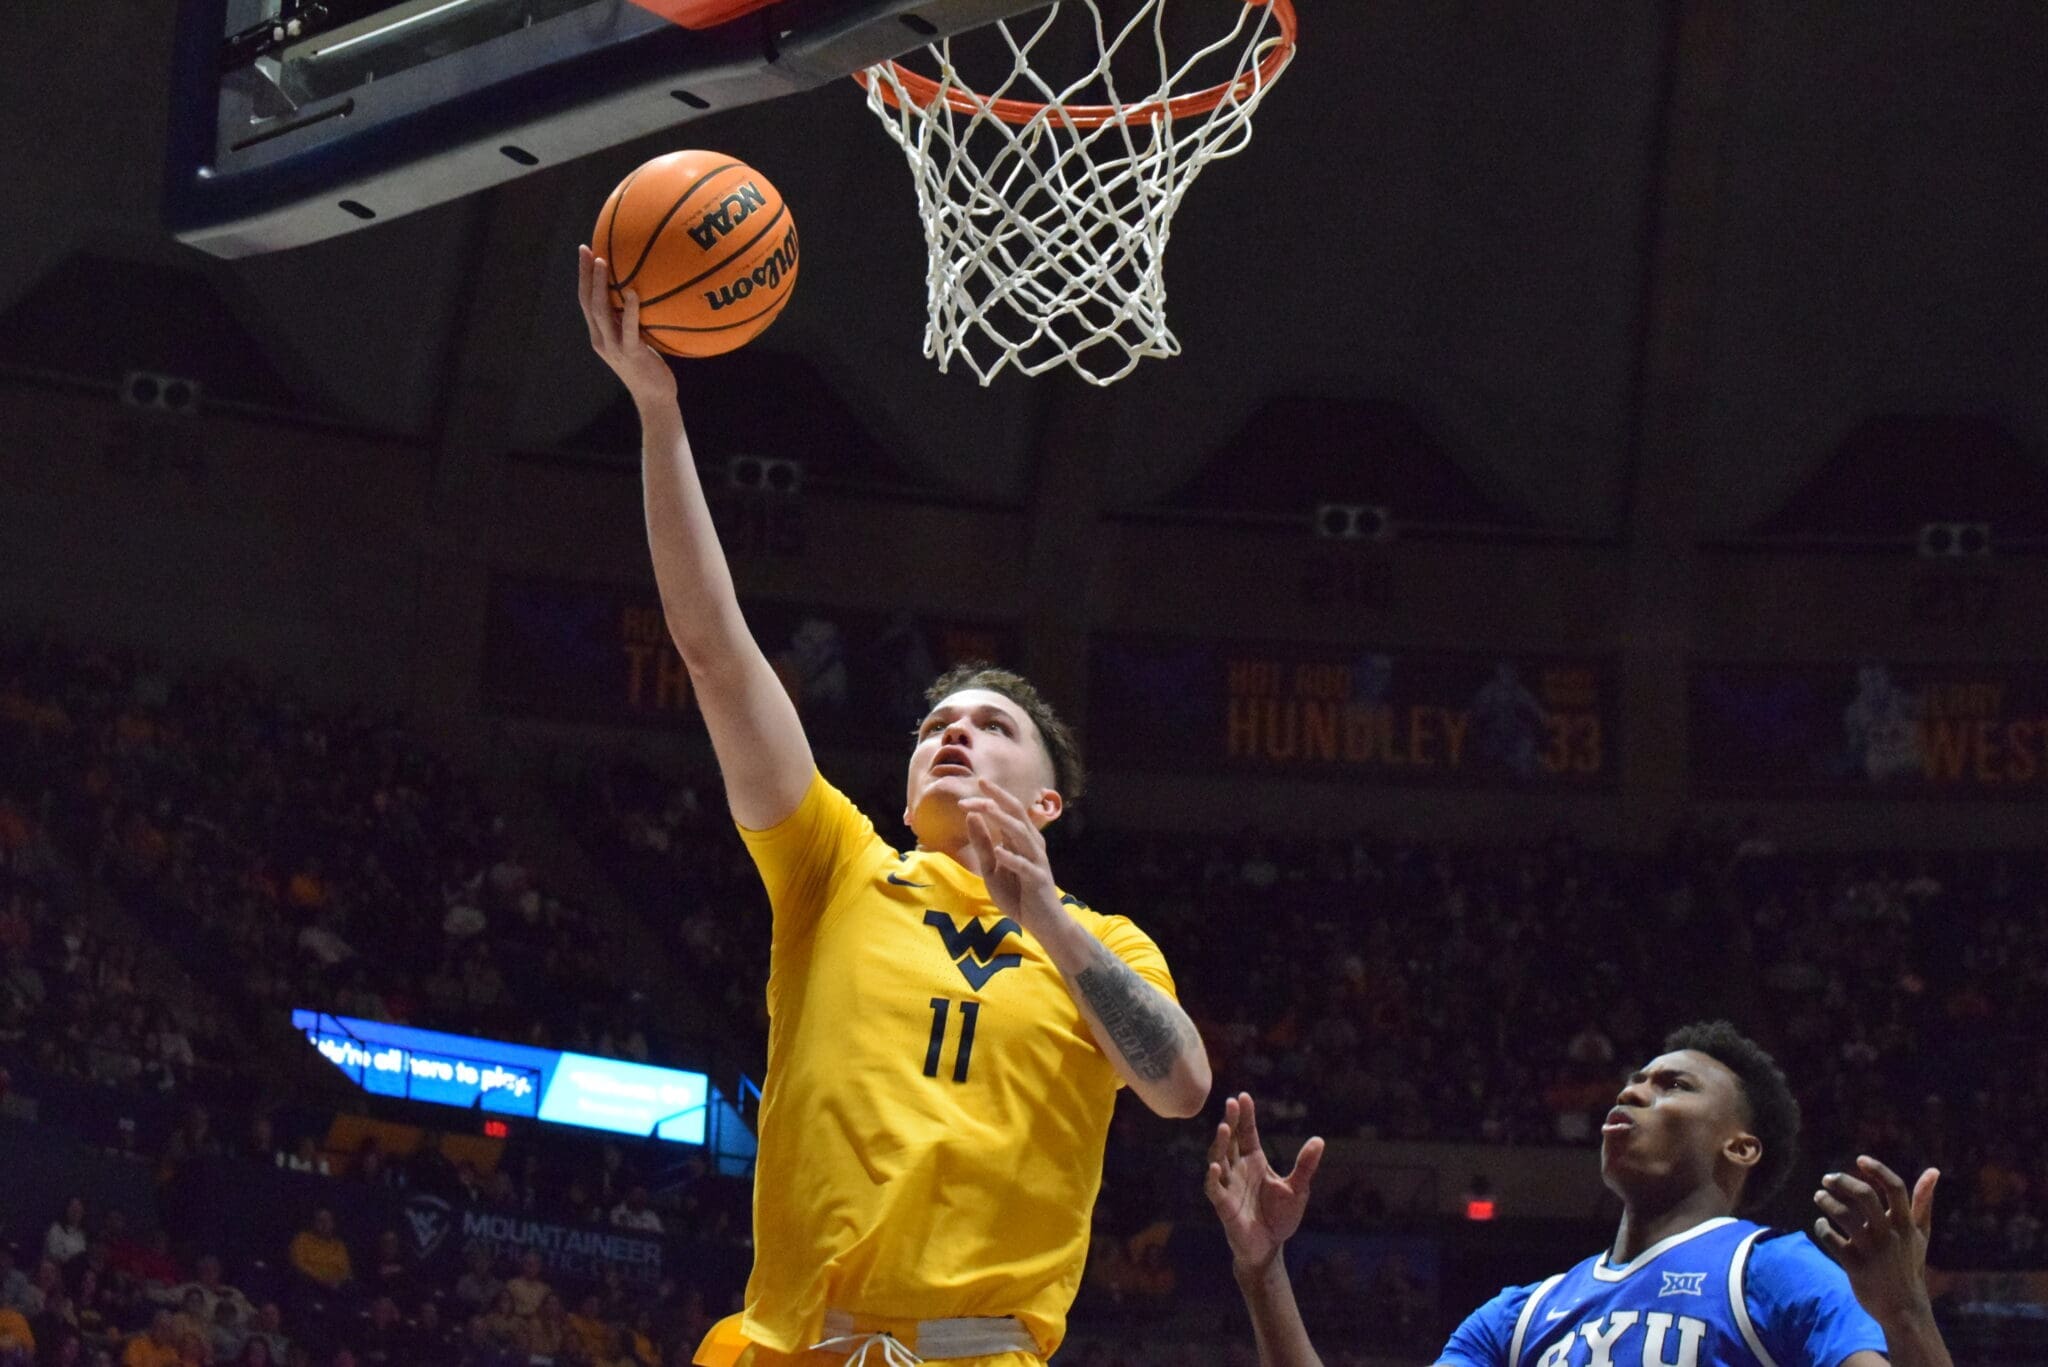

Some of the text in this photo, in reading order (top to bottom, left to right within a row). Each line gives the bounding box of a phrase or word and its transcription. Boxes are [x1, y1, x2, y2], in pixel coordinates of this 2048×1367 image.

[687, 181, 767, 251] NCAA
[703, 223, 799, 311] Wilson
[1227, 697, 1468, 769] HUNDLEY
[1538, 711, 1601, 774] 33
[922, 997, 980, 1083] 11
[455, 1061, 479, 1085] to
[462, 1210, 663, 1266] MOUNTAINEER
[1663, 1273, 1703, 1296] XII
[1536, 1311, 1707, 1367] BYU
